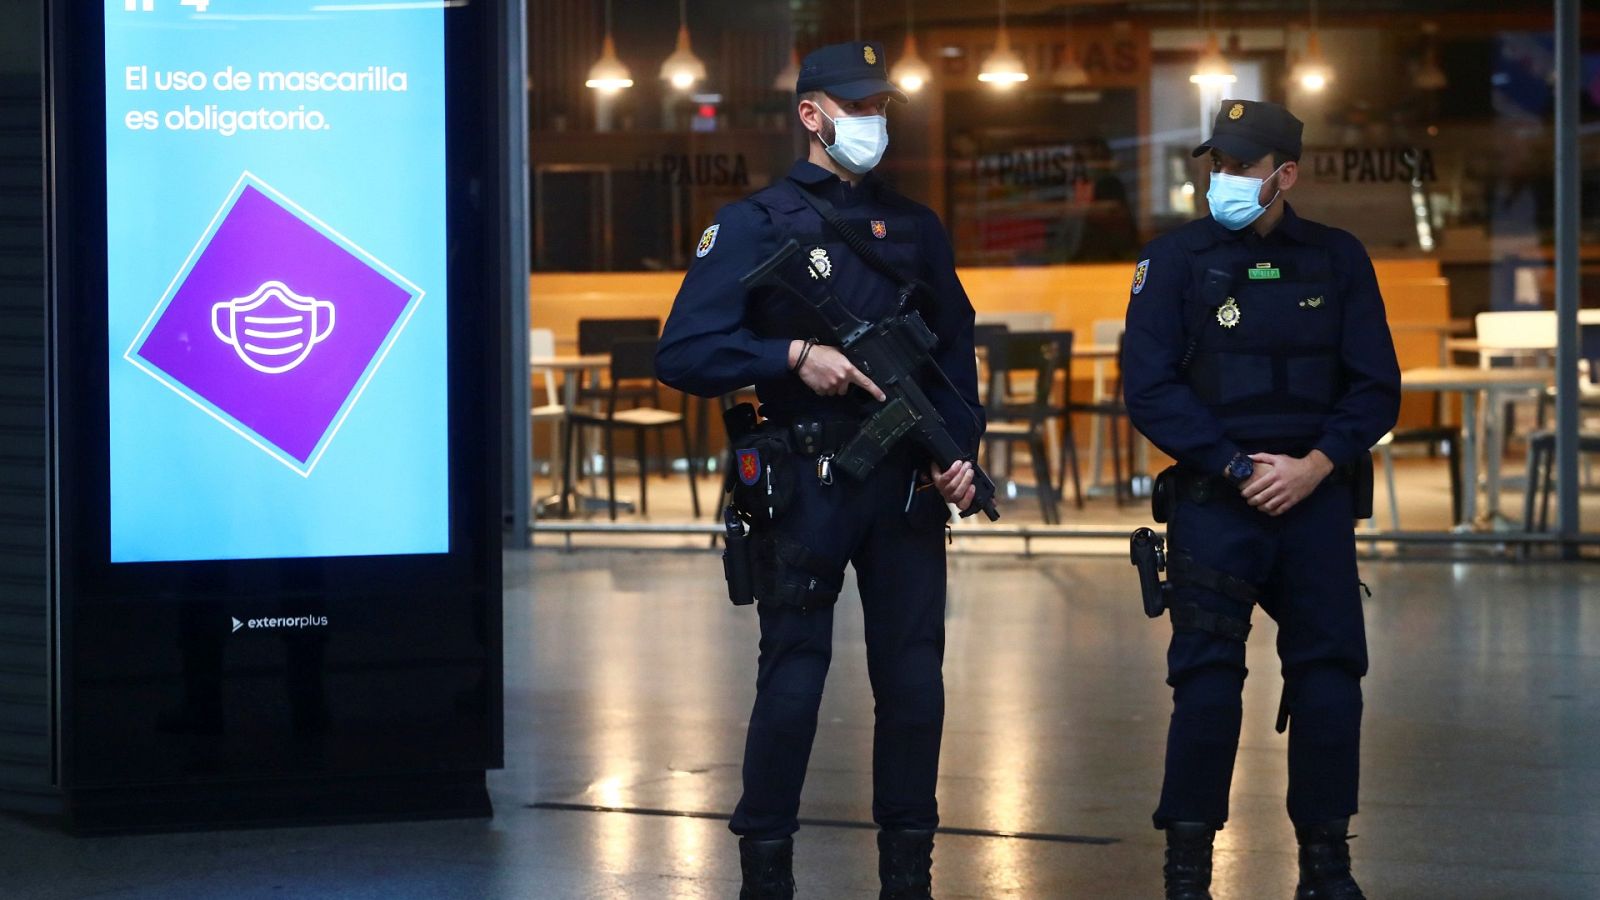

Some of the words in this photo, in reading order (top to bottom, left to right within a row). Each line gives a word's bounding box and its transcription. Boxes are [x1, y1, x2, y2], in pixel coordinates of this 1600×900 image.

[125, 66, 148, 91] El
[155, 70, 207, 92] uso
[213, 66, 251, 92] de
[258, 66, 408, 92] mascarilla
[124, 109, 159, 130] es
[165, 104, 330, 136] obligatorio.
[661, 153, 749, 186] PAUSA
[1343, 148, 1436, 182] PAUSA
[247, 613, 329, 629] exteriorplus
